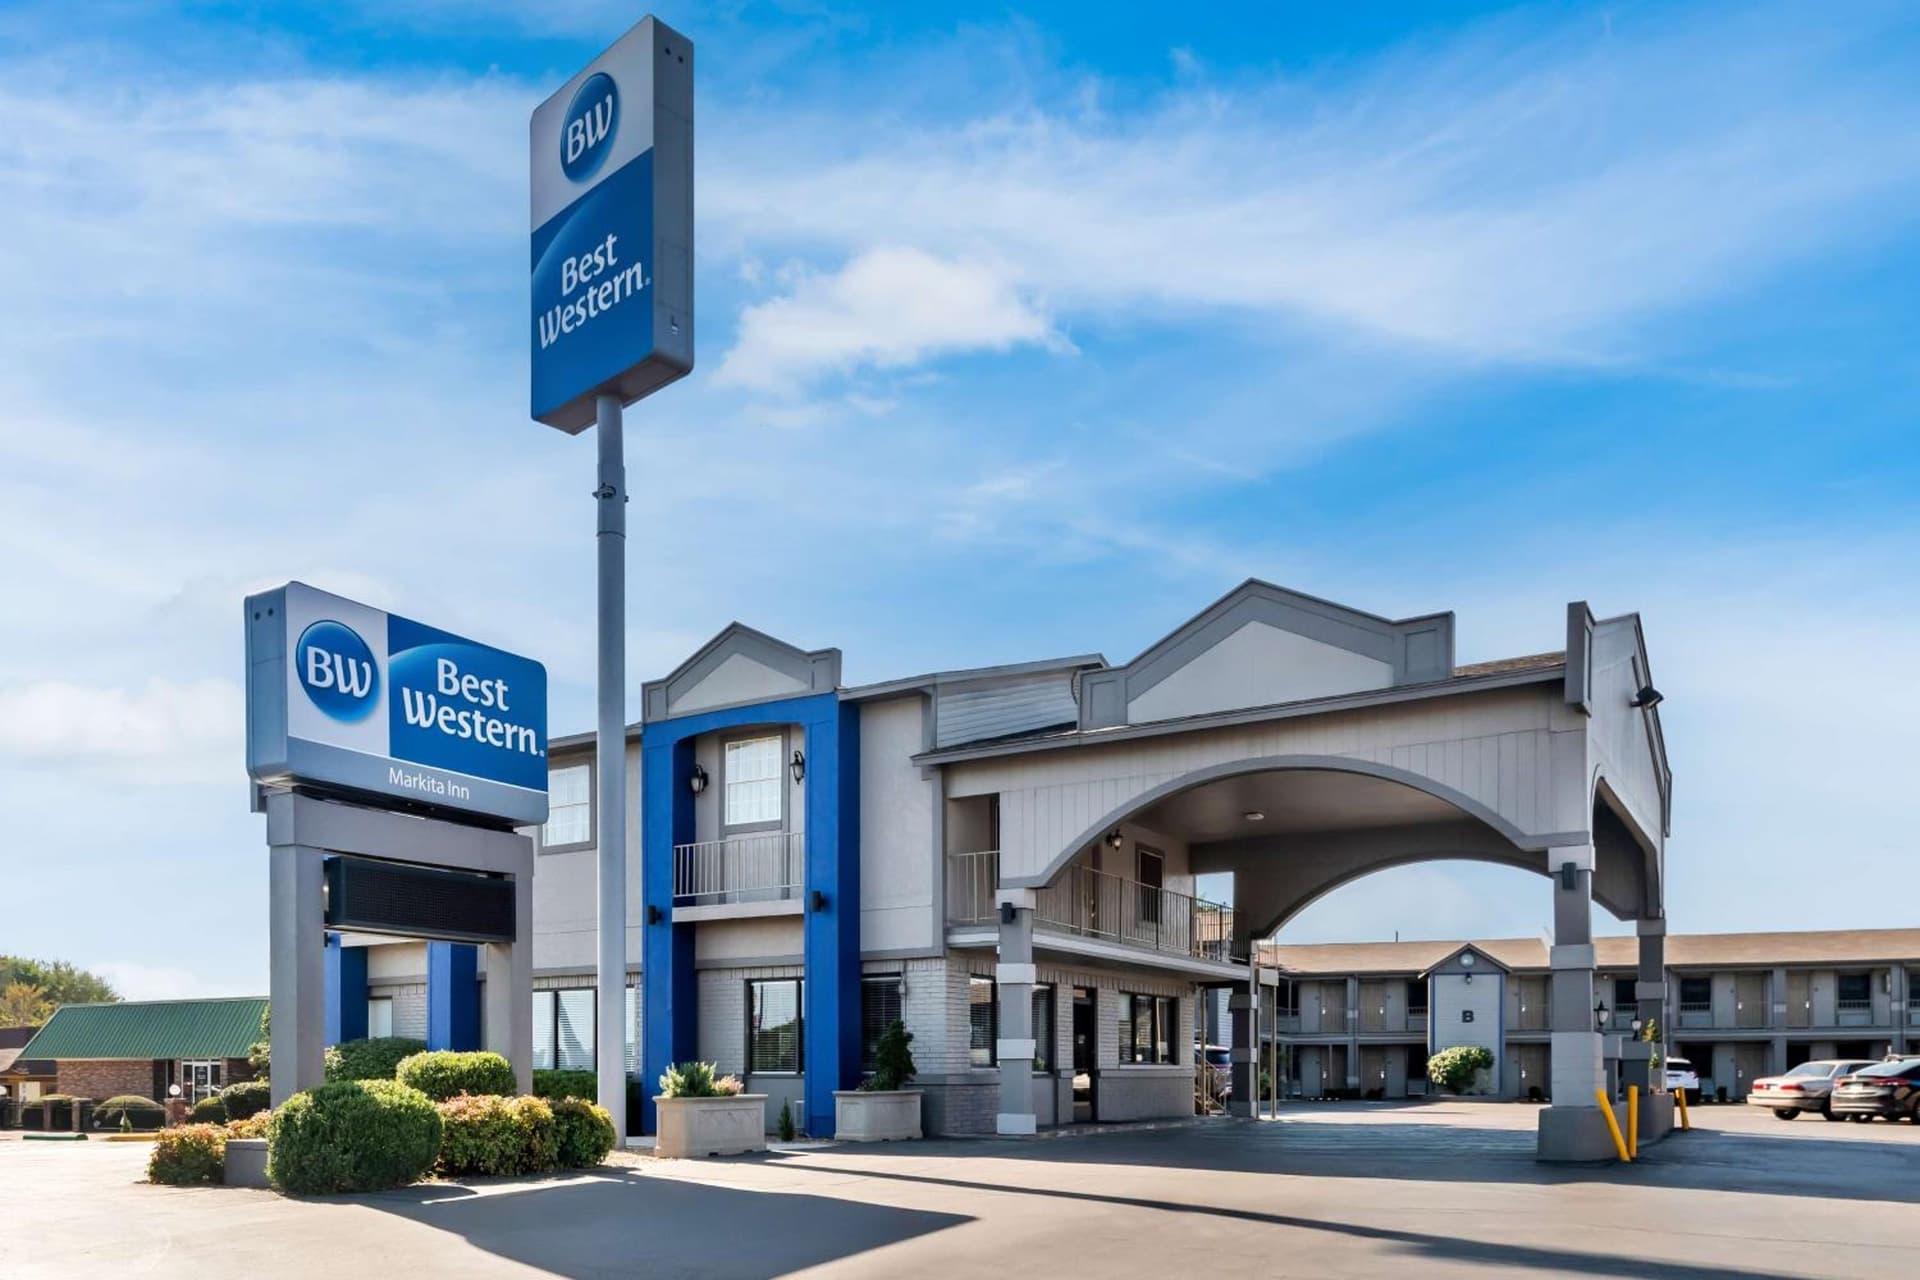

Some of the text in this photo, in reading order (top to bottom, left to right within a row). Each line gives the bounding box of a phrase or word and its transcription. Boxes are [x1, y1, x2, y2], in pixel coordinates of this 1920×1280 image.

[566, 93, 613, 165] BW
[562, 233, 618, 297] Best
[306, 645, 372, 699] BW
[437, 657, 510, 712] Best
[389, 767, 470, 800] Markita Inn
[1462, 1010, 1474, 1023] B
